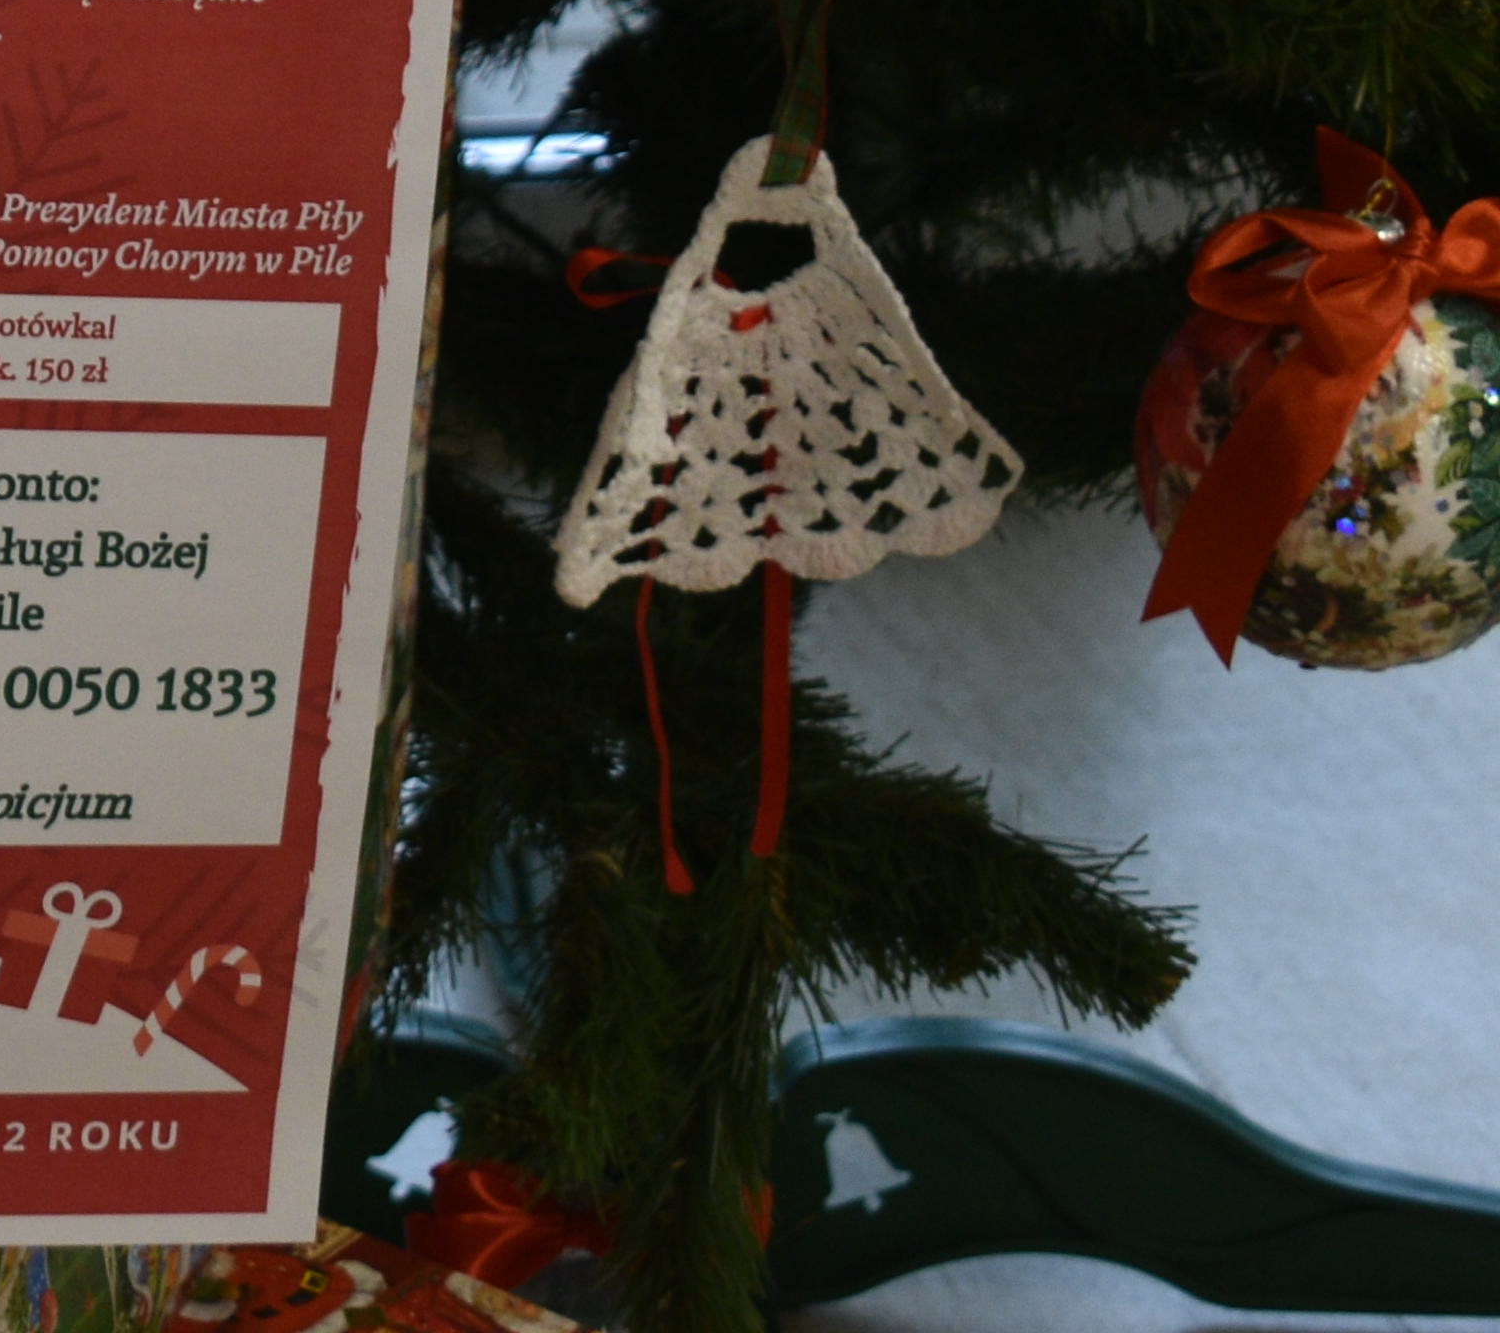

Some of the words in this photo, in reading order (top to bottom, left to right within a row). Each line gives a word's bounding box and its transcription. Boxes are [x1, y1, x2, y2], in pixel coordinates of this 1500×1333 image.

[0, 192, 169, 233] Prezydent
[172, 197, 289, 230] Miasta
[295, 199, 364, 241] Piły
[114, 237, 247, 281] Chorym
[254, 252, 284, 274] w
[288, 243, 353, 277] Pile
[26, 358, 75, 385] 150
[81, 356, 109, 384] zł
[94, 530, 209, 580] Bożej
[3, 665, 140, 716] 0050
[156, 666, 277, 718] 1833
[48, 1120, 179, 1152] ROKU
